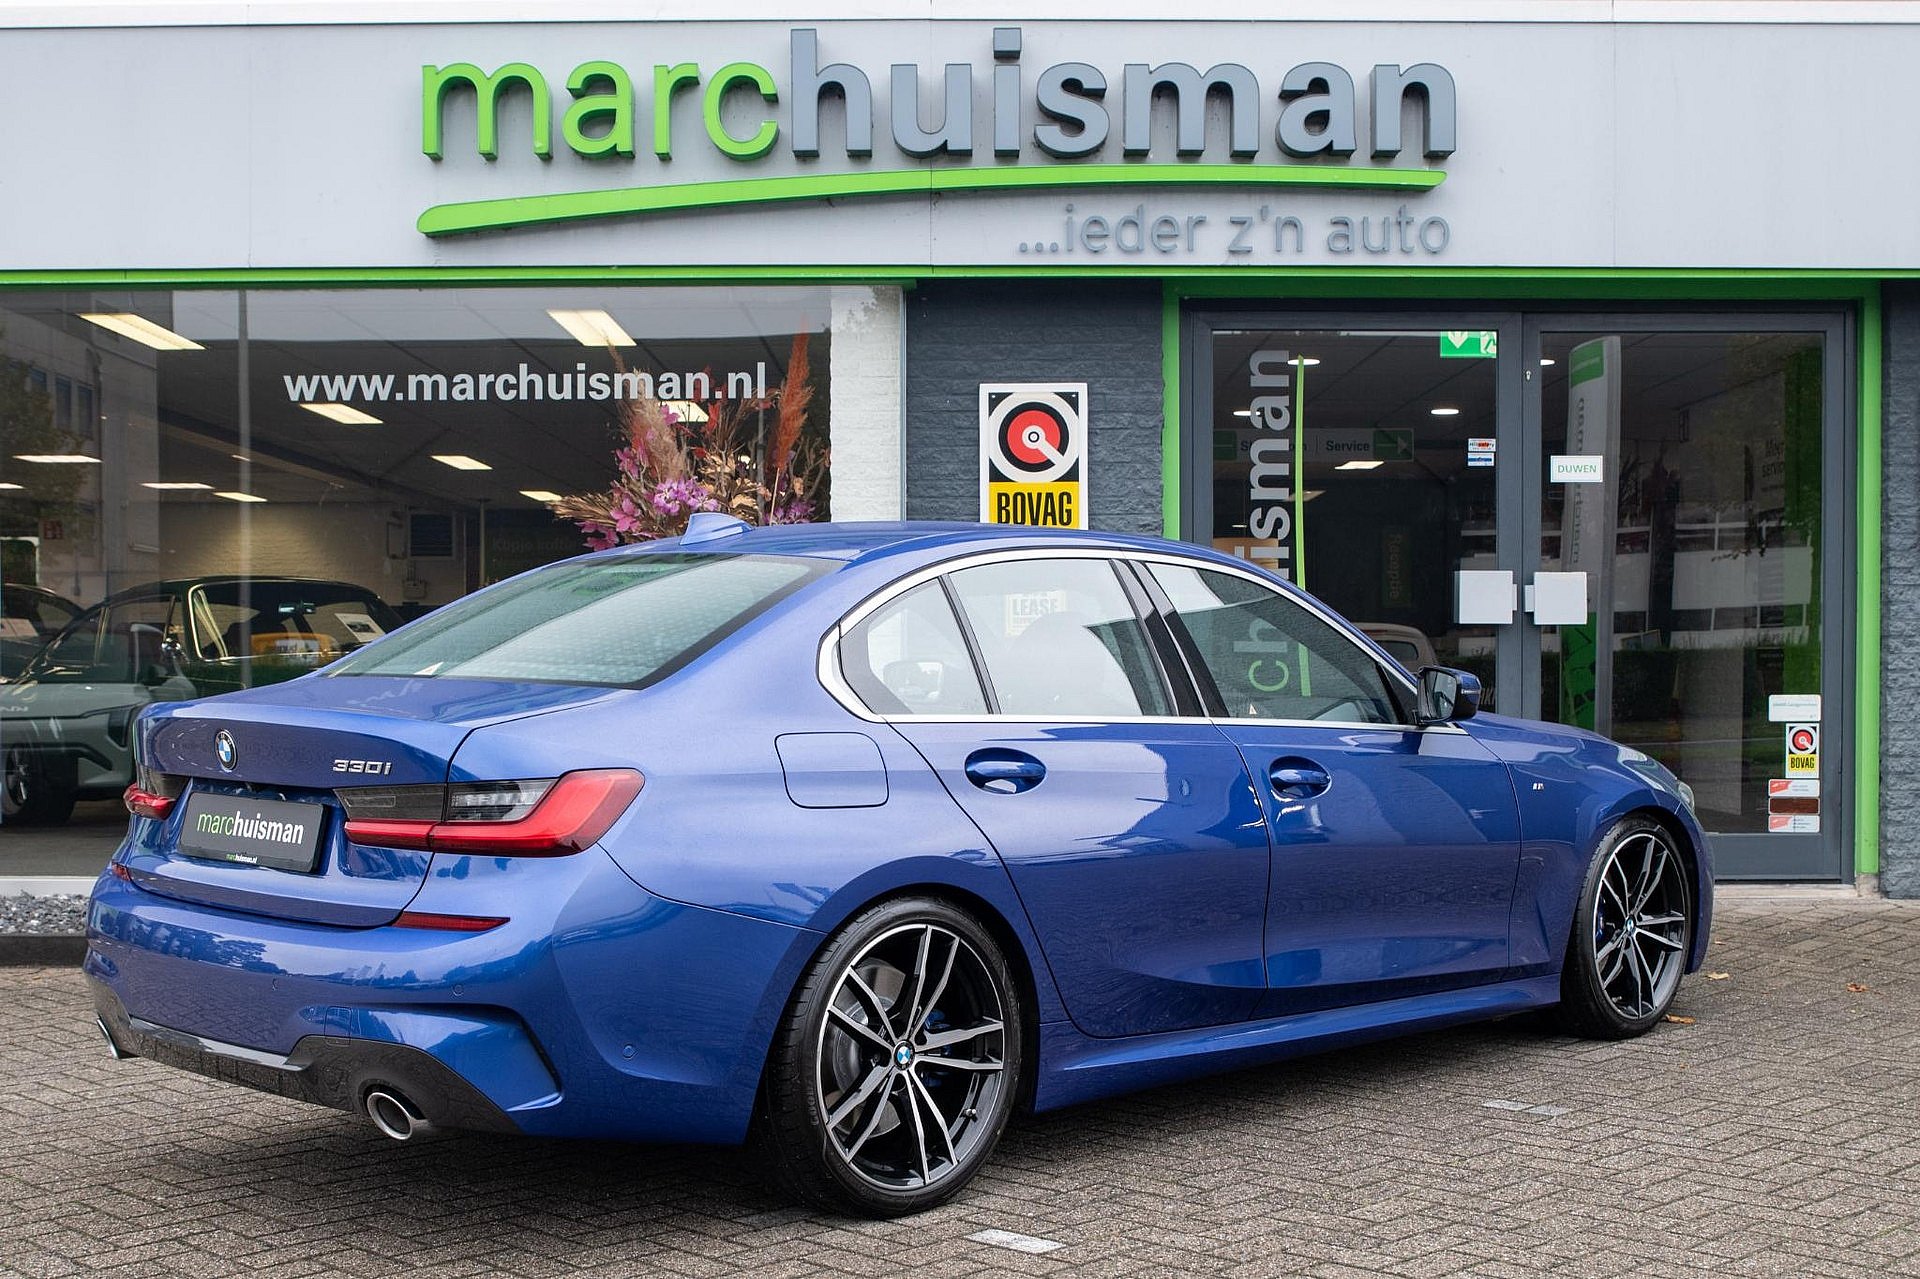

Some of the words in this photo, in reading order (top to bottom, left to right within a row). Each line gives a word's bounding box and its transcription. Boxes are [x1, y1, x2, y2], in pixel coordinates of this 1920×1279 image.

[422, 28, 1457, 160] marchuisman
[1228, 204, 1303, 254] z'n
[1326, 204, 1451, 254] auto
[283, 361, 767, 402] www.marchuisman.nl
[1326, 440, 1371, 452] Service
[1557, 464, 1598, 473] DUWEN
[997, 491, 1072, 526] BOVAG
[1012, 598, 1059, 616] LEASE
[332, 759, 392, 775] 330i
[1790, 757, 1815, 769] BOVAG
[197, 810, 305, 845] marchuisman
